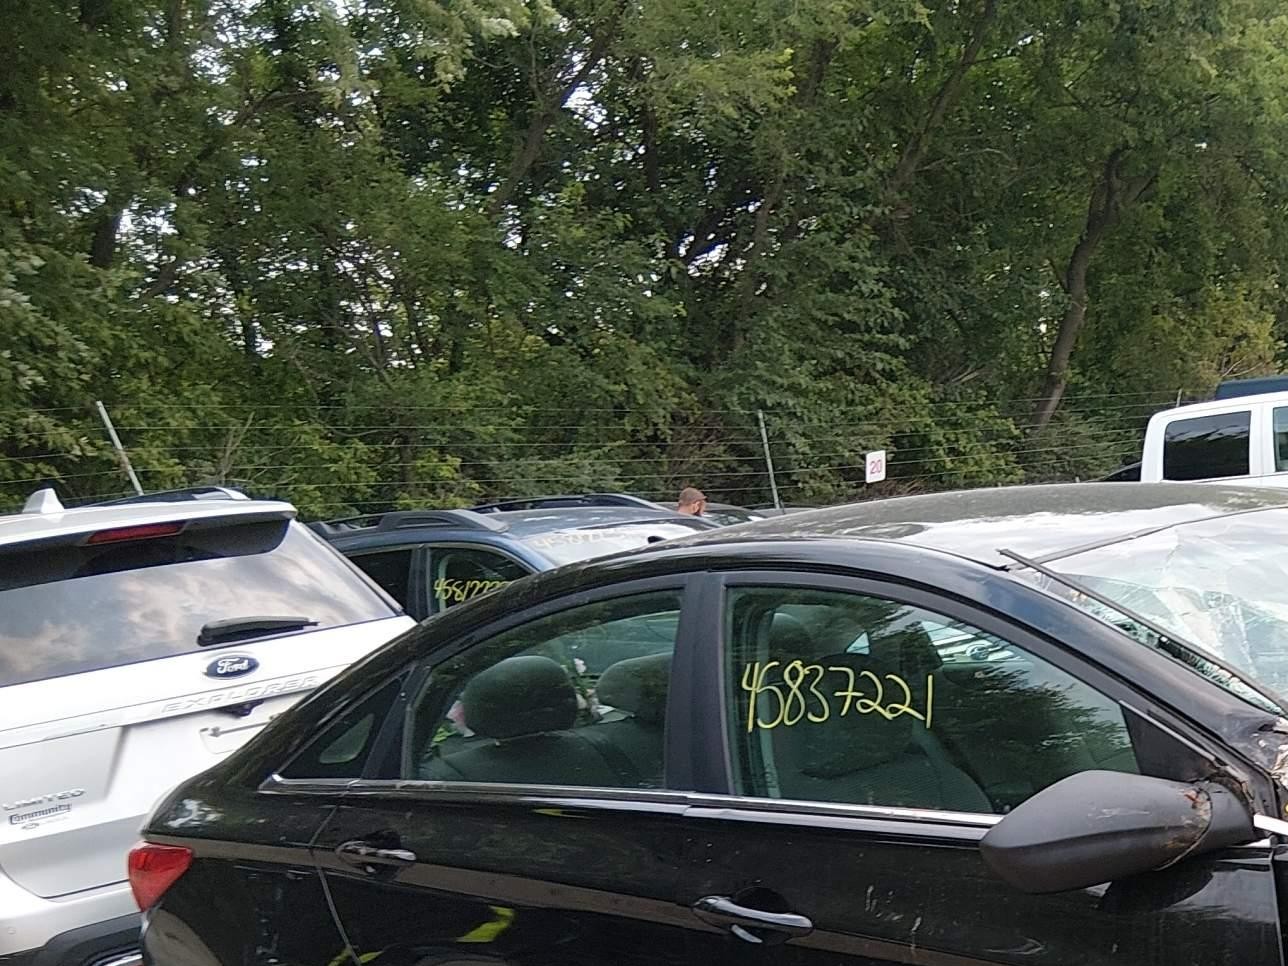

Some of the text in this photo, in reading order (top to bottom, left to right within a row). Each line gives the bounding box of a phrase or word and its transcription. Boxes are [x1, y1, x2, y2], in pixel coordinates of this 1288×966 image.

[869, 459, 883, 475] 20
[216, 657, 249, 674] Ford
[161, 676, 320, 713] EXPLORER
[741, 660, 934, 734] 45837221
